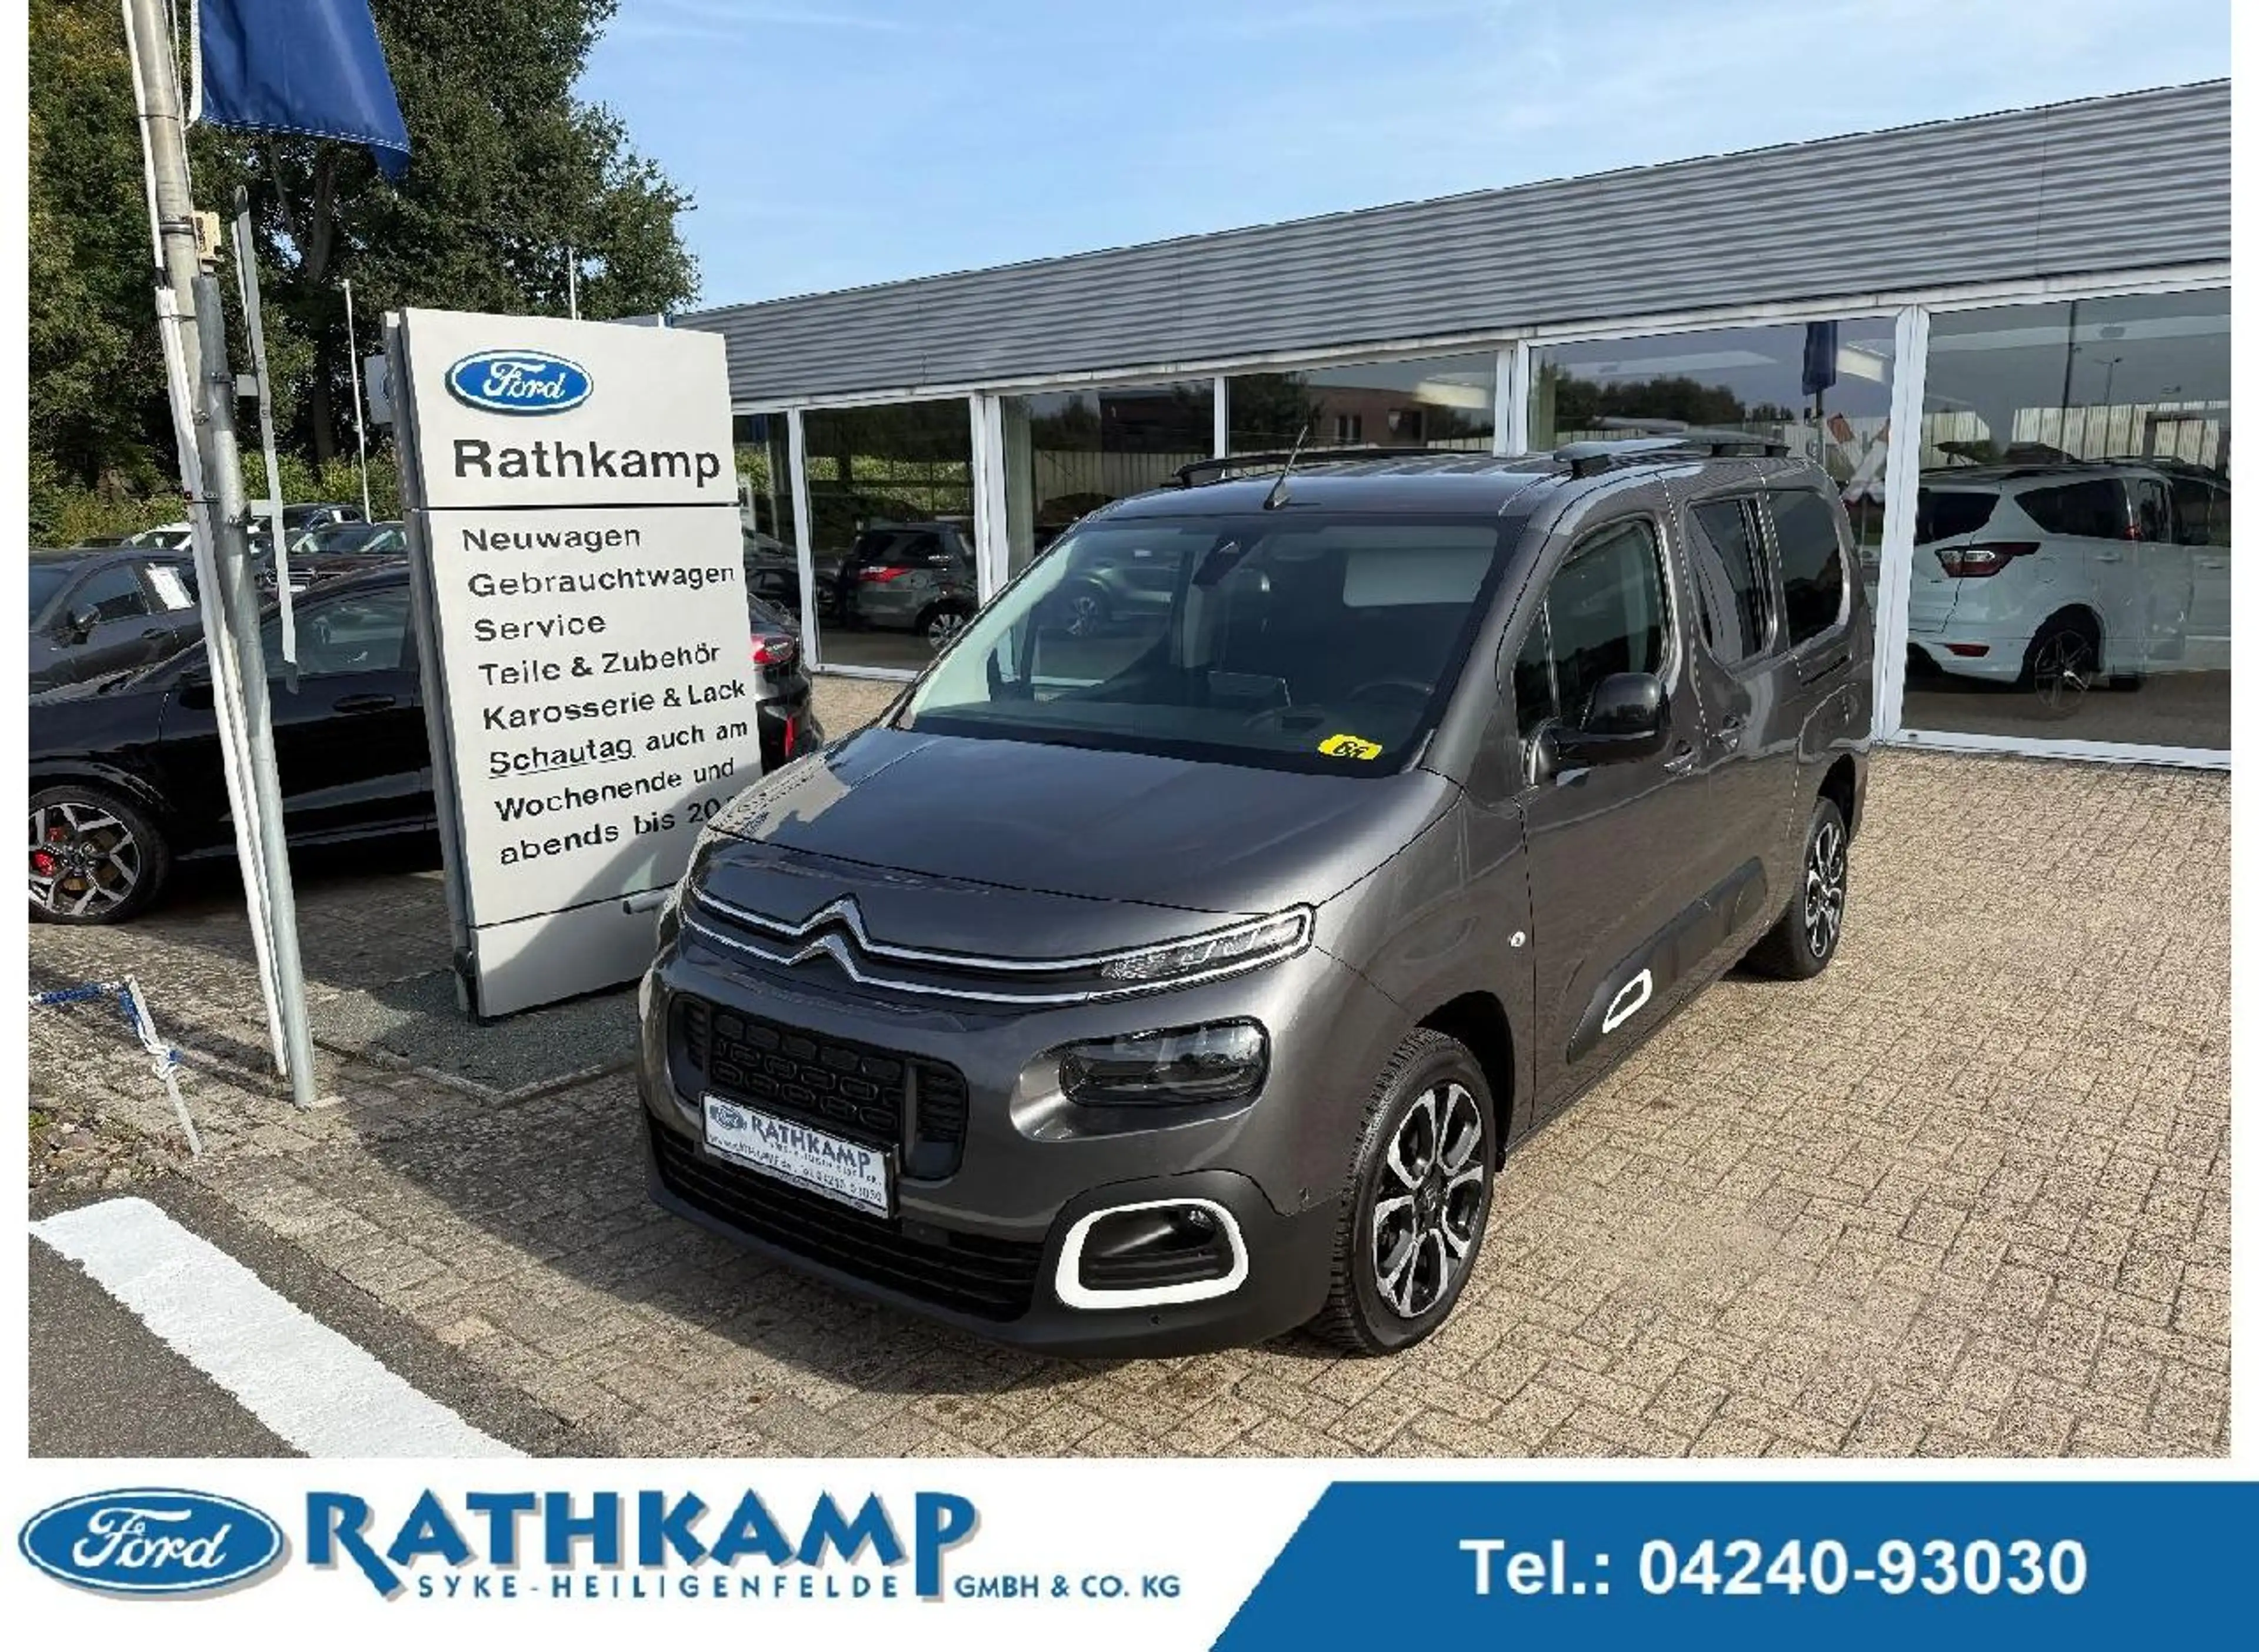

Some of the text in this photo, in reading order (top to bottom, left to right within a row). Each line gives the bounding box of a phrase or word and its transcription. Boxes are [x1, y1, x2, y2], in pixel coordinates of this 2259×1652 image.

[483, 360, 567, 399] Ford
[454, 439, 720, 488] Rathkamp
[462, 529, 640, 553] Neuwagen
[468, 568, 734, 597] Gebrauchtwagen
[474, 614, 606, 642] Service
[478, 642, 721, 685] Teile & Zubehör
[483, 679, 746, 730] Karosserie & Lack
[489, 721, 748, 777] Schautag auch am
[495, 757, 735, 822] Wochenende und
[500, 823, 619, 865] abends
[633, 810, 676, 836] bis
[751, 1115, 871, 1177] RATHKAMP
